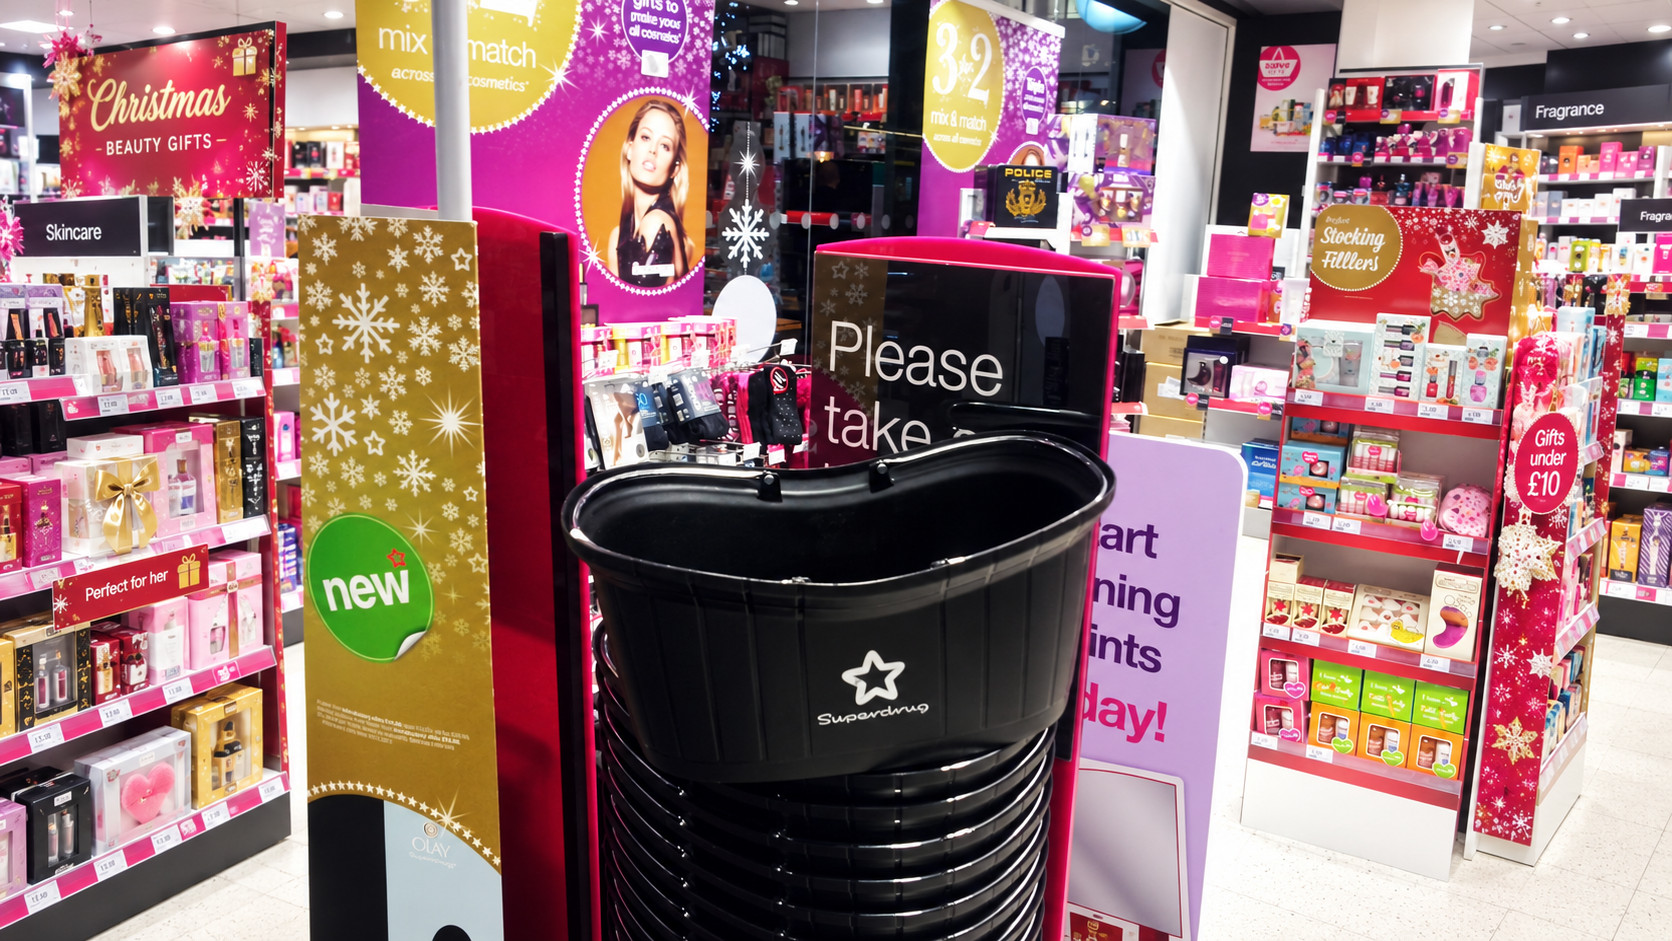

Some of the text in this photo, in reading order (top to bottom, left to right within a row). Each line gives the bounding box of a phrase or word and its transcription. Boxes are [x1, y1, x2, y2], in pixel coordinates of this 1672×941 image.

[378, 24, 536, 69] mix match
[391, 67, 434, 82] across
[932, 22, 958, 95] 3
[967, 33, 992, 109] 2
[87, 78, 231, 132] Christmas
[1535, 103, 1605, 121] Fragrance
[931, 108, 986, 131] mix & match
[106, 133, 212, 156] BEAUTY GIFTS
[1005, 168, 1052, 179] POLICE
[1640, 211, 1672, 223] Fragra
[46, 223, 102, 241] Skincare
[1320, 226, 1386, 253] Stocking
[829, 320, 1003, 397] Please
[824, 396, 931, 454] take
[1535, 428, 1565, 447] Gifts
[1530, 449, 1567, 466] under
[1527, 470, 1560, 497] £10
[1098, 523, 1159, 559] art
[85, 570, 168, 602] Perfect for her
[322, 569, 410, 612] new
[1093, 573, 1181, 629] ning
[1088, 623, 1162, 674] ints
[817, 702, 929, 726] Superdrug
[1083, 681, 1168, 744] day!
[411, 836, 451, 858] OLAY
